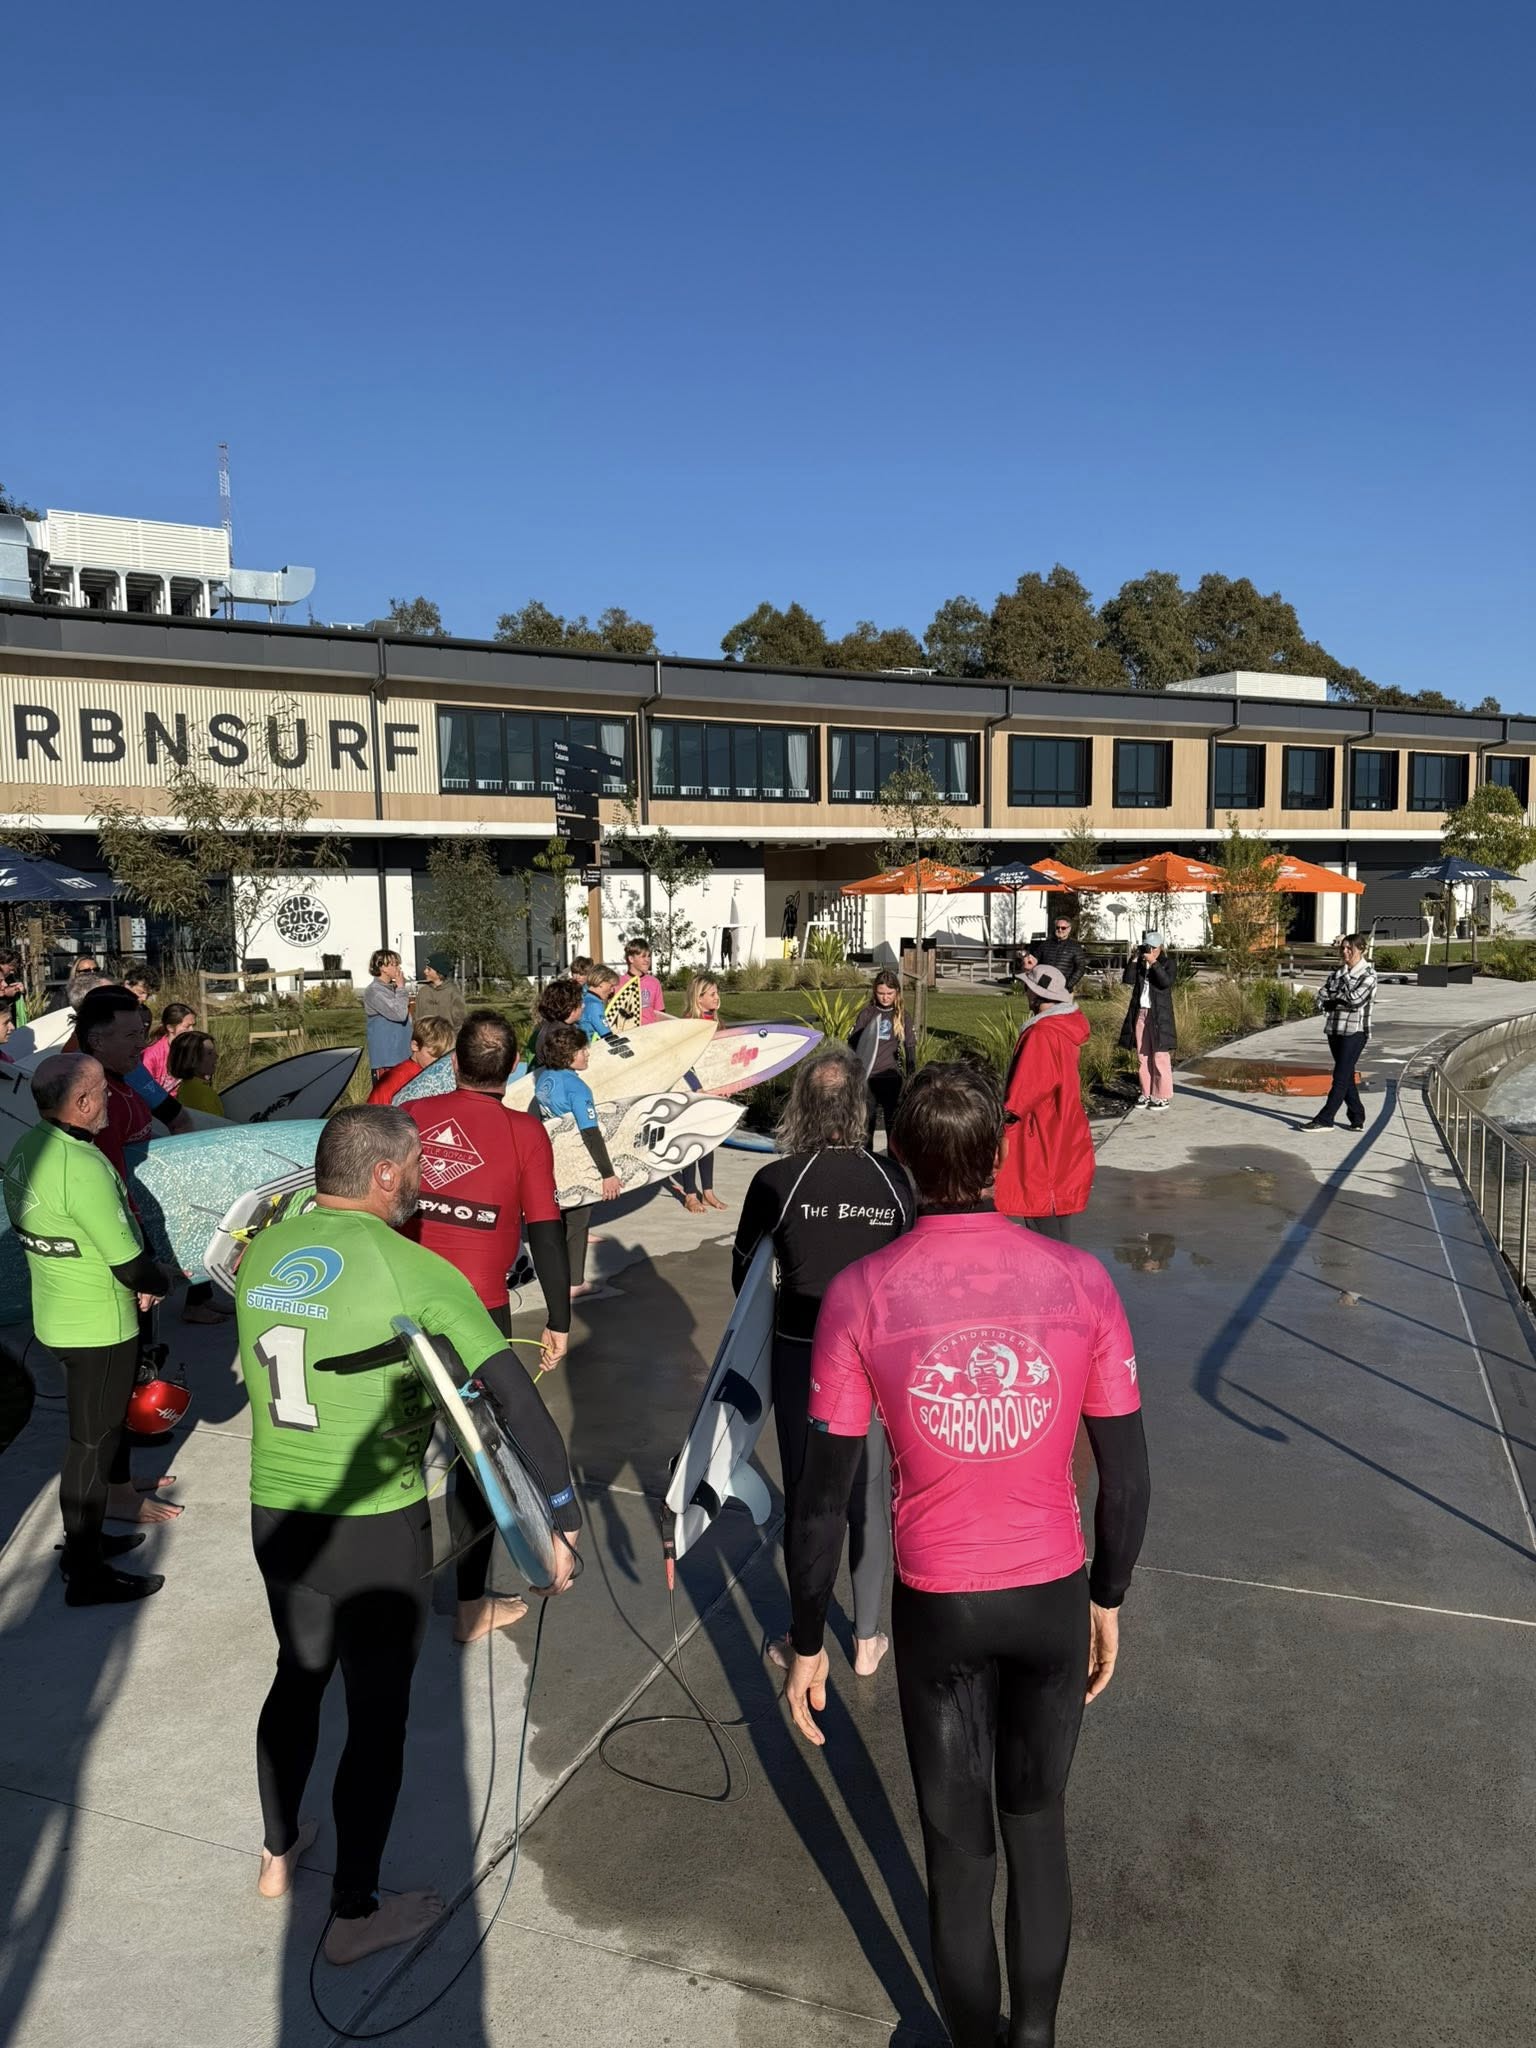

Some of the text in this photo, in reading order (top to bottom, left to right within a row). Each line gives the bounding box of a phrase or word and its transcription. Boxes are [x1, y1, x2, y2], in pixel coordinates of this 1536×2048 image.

[13, 704, 420, 772] RBNSURF
[1458, 870, 1490, 878] YETI
[278, 896, 311, 915] RIP
[277, 910, 328, 928] CURL
[586, 1108, 596, 1120] 3
[801, 1203, 896, 1219] THE BEACHES
[247, 1293, 329, 1320] SURFRIDER
[933, 1329, 1035, 1360] BOARDRIDERS
[252, 1323, 320, 1432] 1
[919, 1397, 1053, 1456] SCARBOROUGH
